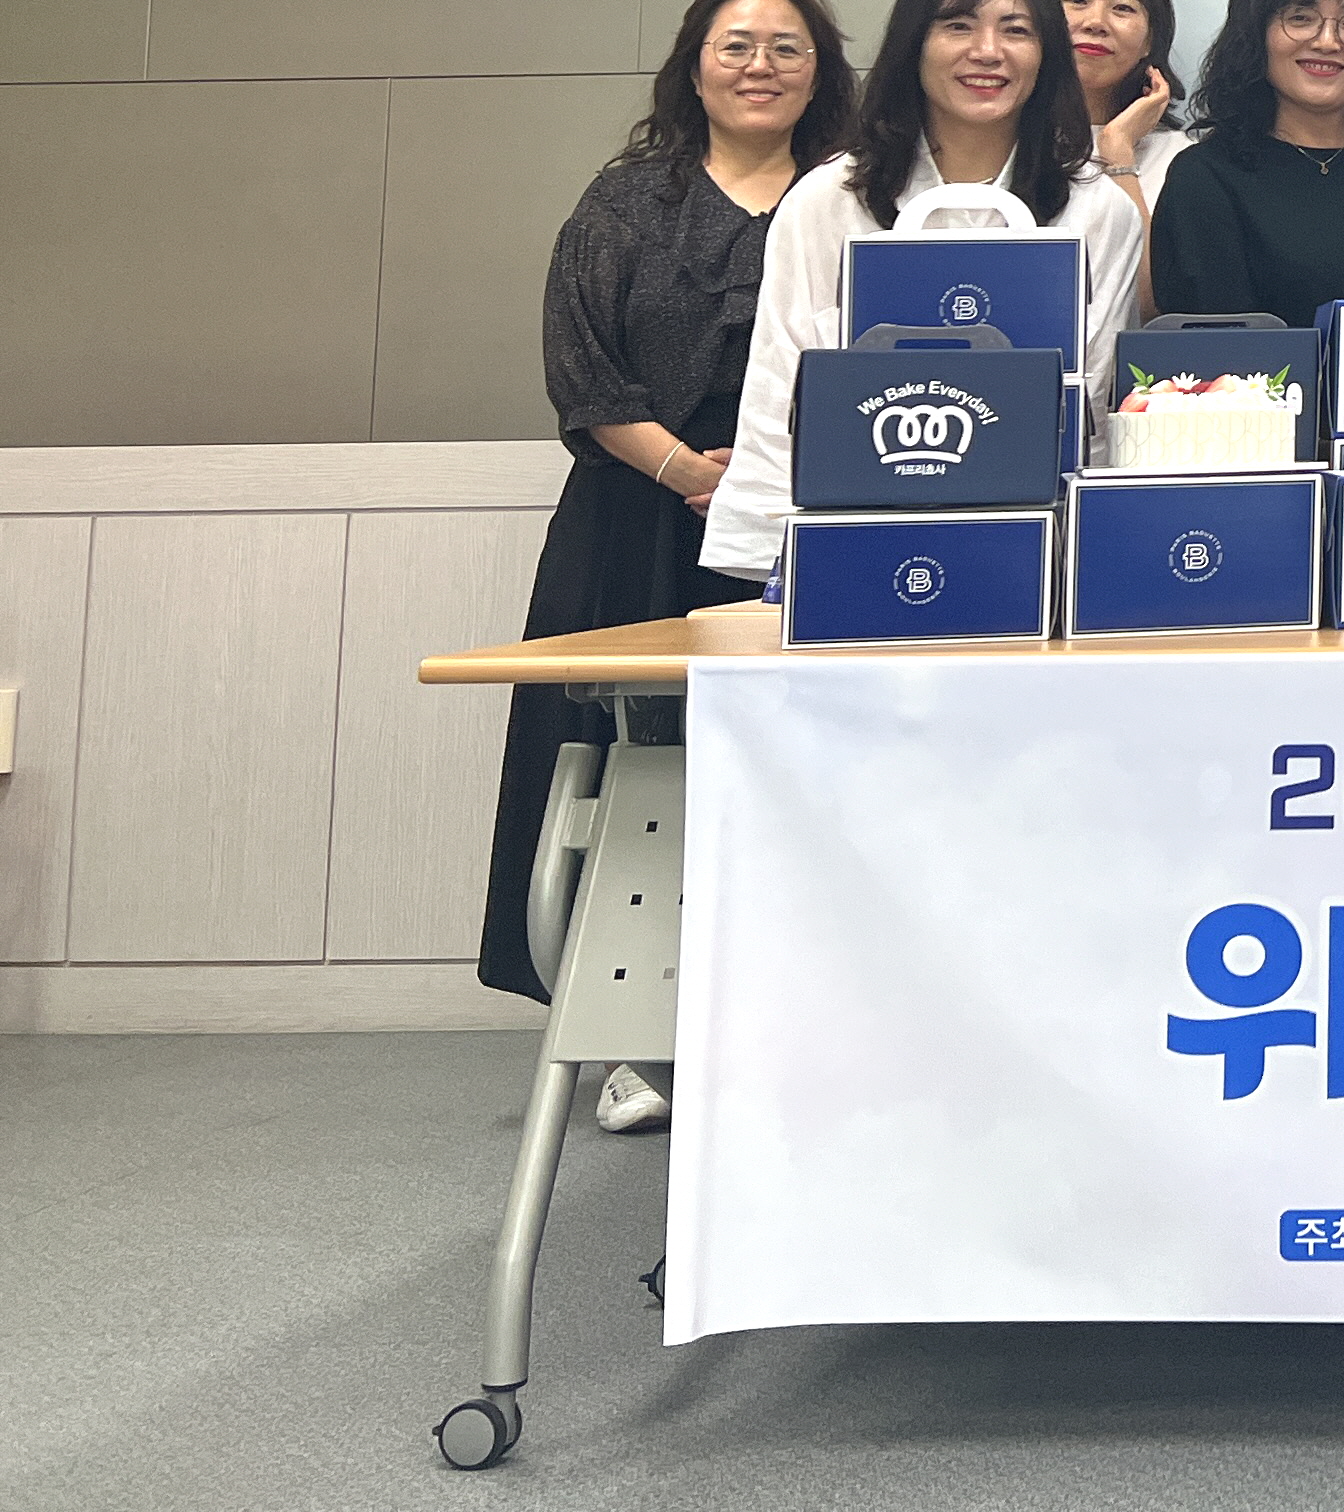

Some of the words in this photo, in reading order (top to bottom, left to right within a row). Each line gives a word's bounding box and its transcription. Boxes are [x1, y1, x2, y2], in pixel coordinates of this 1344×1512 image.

[857, 396, 885, 416] We
[884, 382, 926, 403] Bake
[928, 380, 1000, 426] Everyday!
